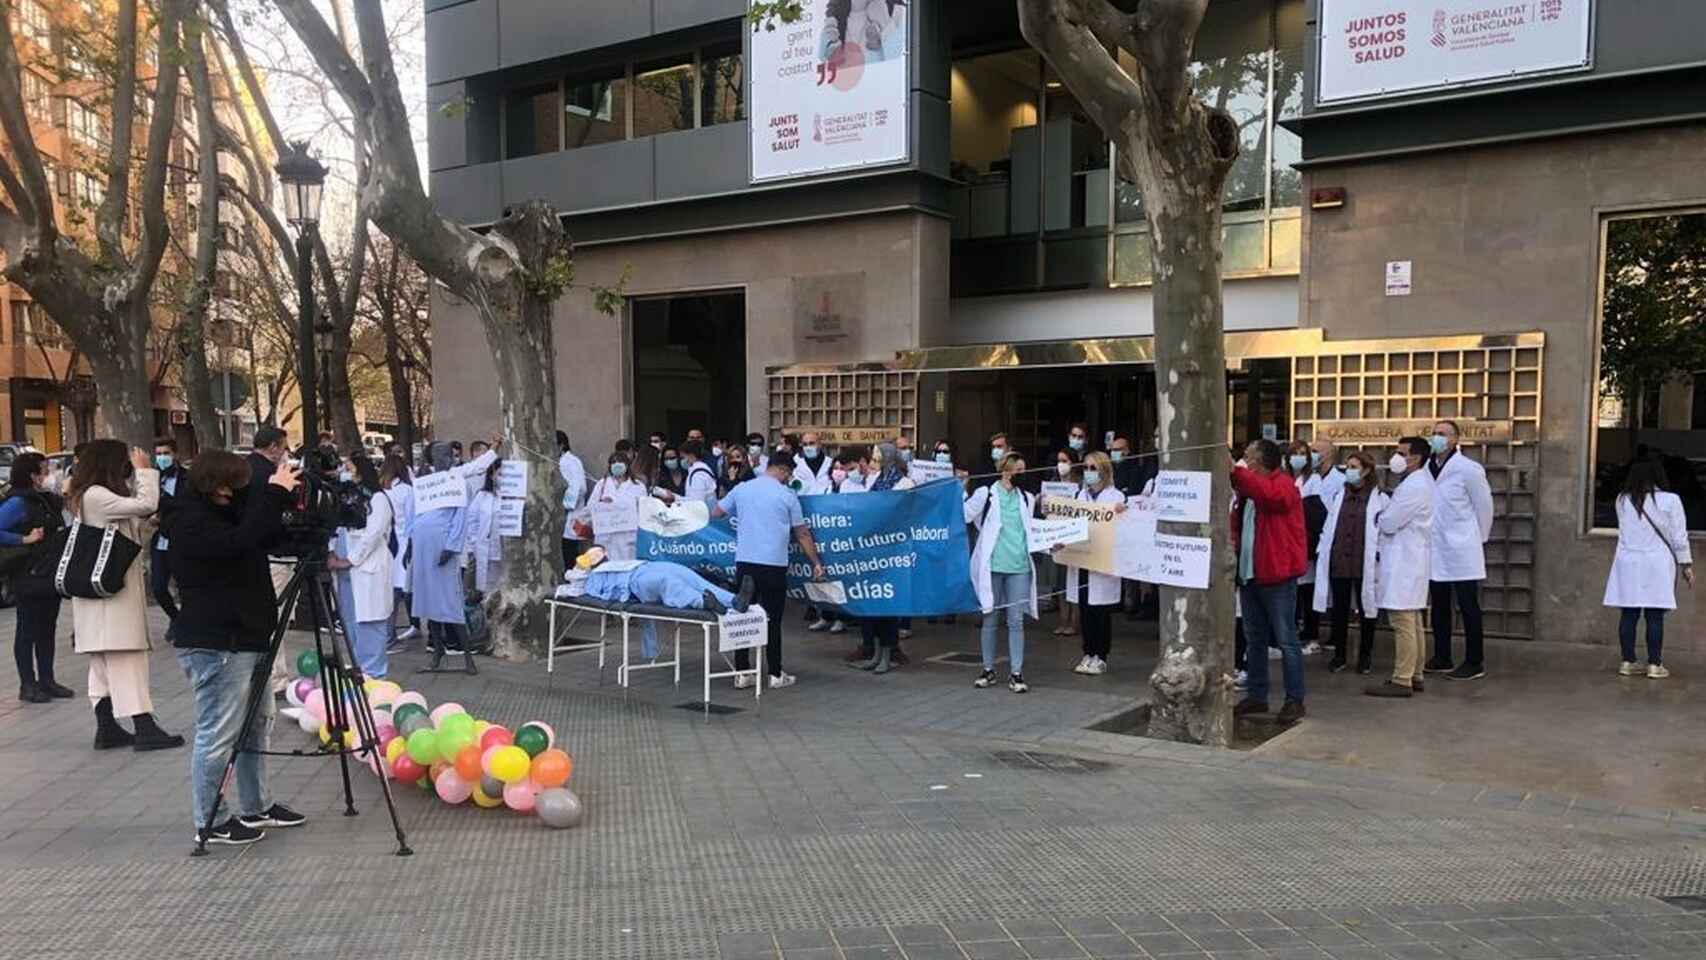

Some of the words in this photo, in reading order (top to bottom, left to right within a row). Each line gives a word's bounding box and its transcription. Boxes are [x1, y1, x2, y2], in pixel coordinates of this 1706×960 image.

[1345, 12, 1407, 34] JUNTOS
[1451, 4, 1526, 25] GENERALITAT
[1452, 17, 1525, 35] VALENCIANA
[787, 28, 813, 46] gent
[1348, 28, 1405, 49] SOMOS
[1355, 46, 1405, 64] SALUD
[777, 61, 813, 78] costat
[769, 114, 799, 128] JUNTS
[777, 127, 799, 139] SOM
[772, 139, 801, 152] SALUT
[1461, 425, 1497, 438] NITAT
[1158, 491, 1198, 500] EMPRESA
[803, 514, 852, 529] ellera:
[708, 541, 738, 555] nos
[830, 539, 854, 553] del
[857, 531, 907, 549] futuro
[822, 552, 918, 576] rabajadores?
[848, 579, 895, 600] días
